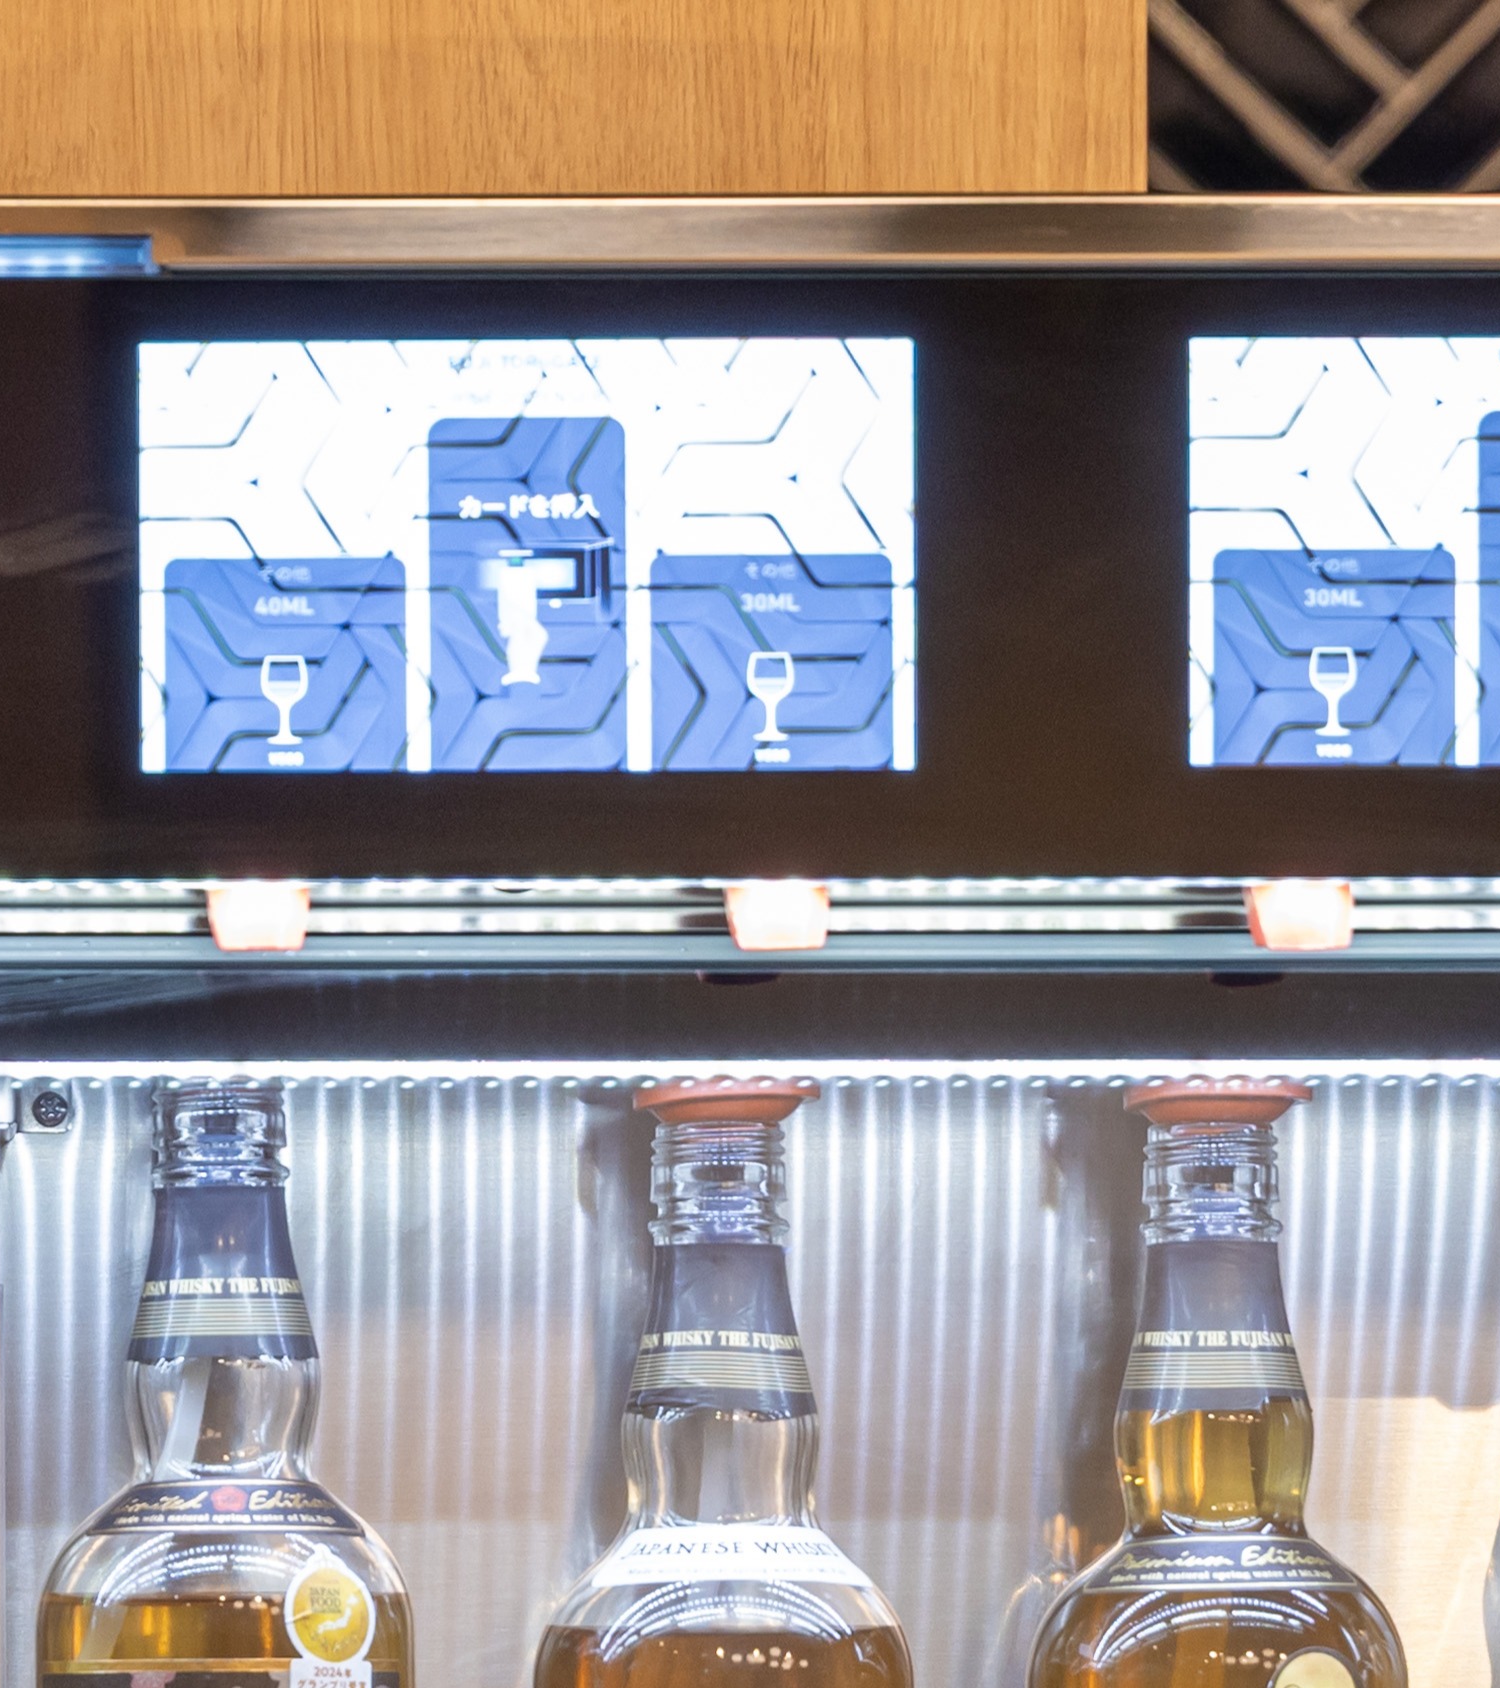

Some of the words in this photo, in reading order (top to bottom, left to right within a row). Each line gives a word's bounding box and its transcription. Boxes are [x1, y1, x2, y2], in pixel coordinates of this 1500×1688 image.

[1304, 588, 1364, 608] 30ML
[169, 1277, 225, 1295] WHISKY
[227, 1277, 259, 1294] THE
[663, 1331, 714, 1347] WHISKY
[718, 1331, 750, 1347] THE
[1143, 1331, 1193, 1347] WHISKY
[1196, 1331, 1228, 1346] THE
[1231, 1331, 1283, 1348] FUJISAN
[167, 1513, 209, 1522] natural
[212, 1513, 251, 1524] spring
[621, 1541, 745, 1560] JAPANESE
[755, 1541, 839, 1557] WHISKY
[1241, 1545, 1333, 1567] Edition
[1139, 1572, 1164, 1581] with
[1167, 1571, 1210, 1580] natural
[1212, 1571, 1251, 1581] spring
[1253, 1570, 1284, 1579] water
